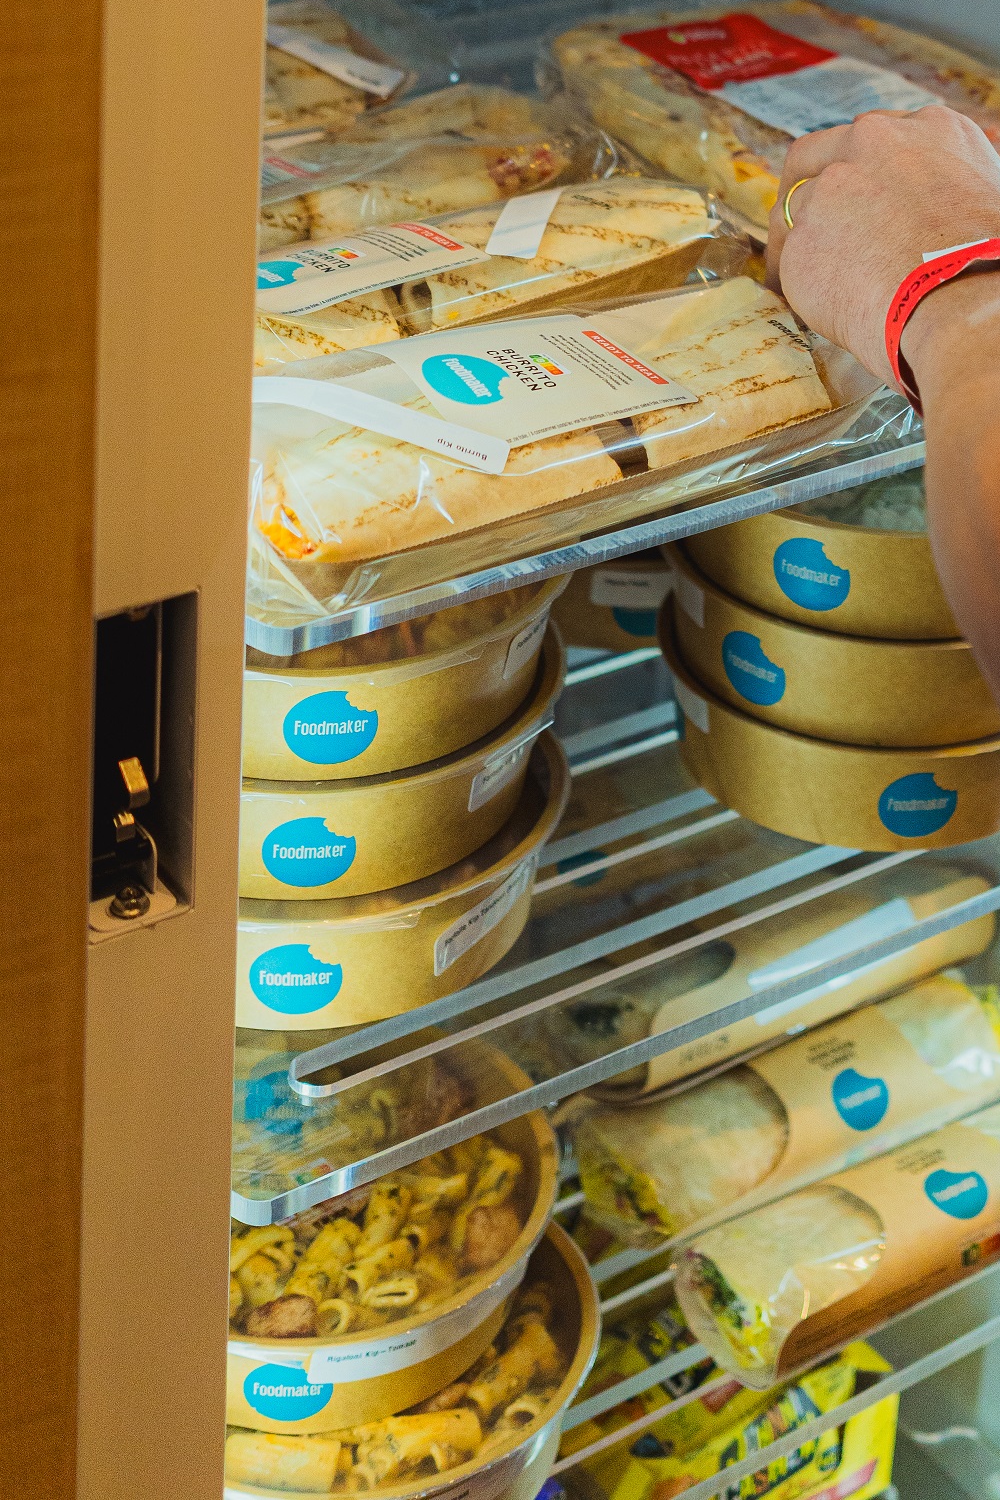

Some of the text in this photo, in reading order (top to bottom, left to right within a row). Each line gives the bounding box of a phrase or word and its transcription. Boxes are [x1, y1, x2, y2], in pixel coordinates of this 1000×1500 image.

[502, 348, 557, 388] BURRITO
[591, 334, 660, 381] READY TO HEAT
[441, 357, 492, 398] Foodmaker
[486, 349, 542, 392] CHICKEN
[437, 438, 488, 461] Burrito Kip
[293, 716, 369, 737] Foodmaker
[272, 842, 347, 861] Foodmaker
[259, 967, 333, 987] Foodmaker
[253, 1382, 323, 1397] Foodmaker
